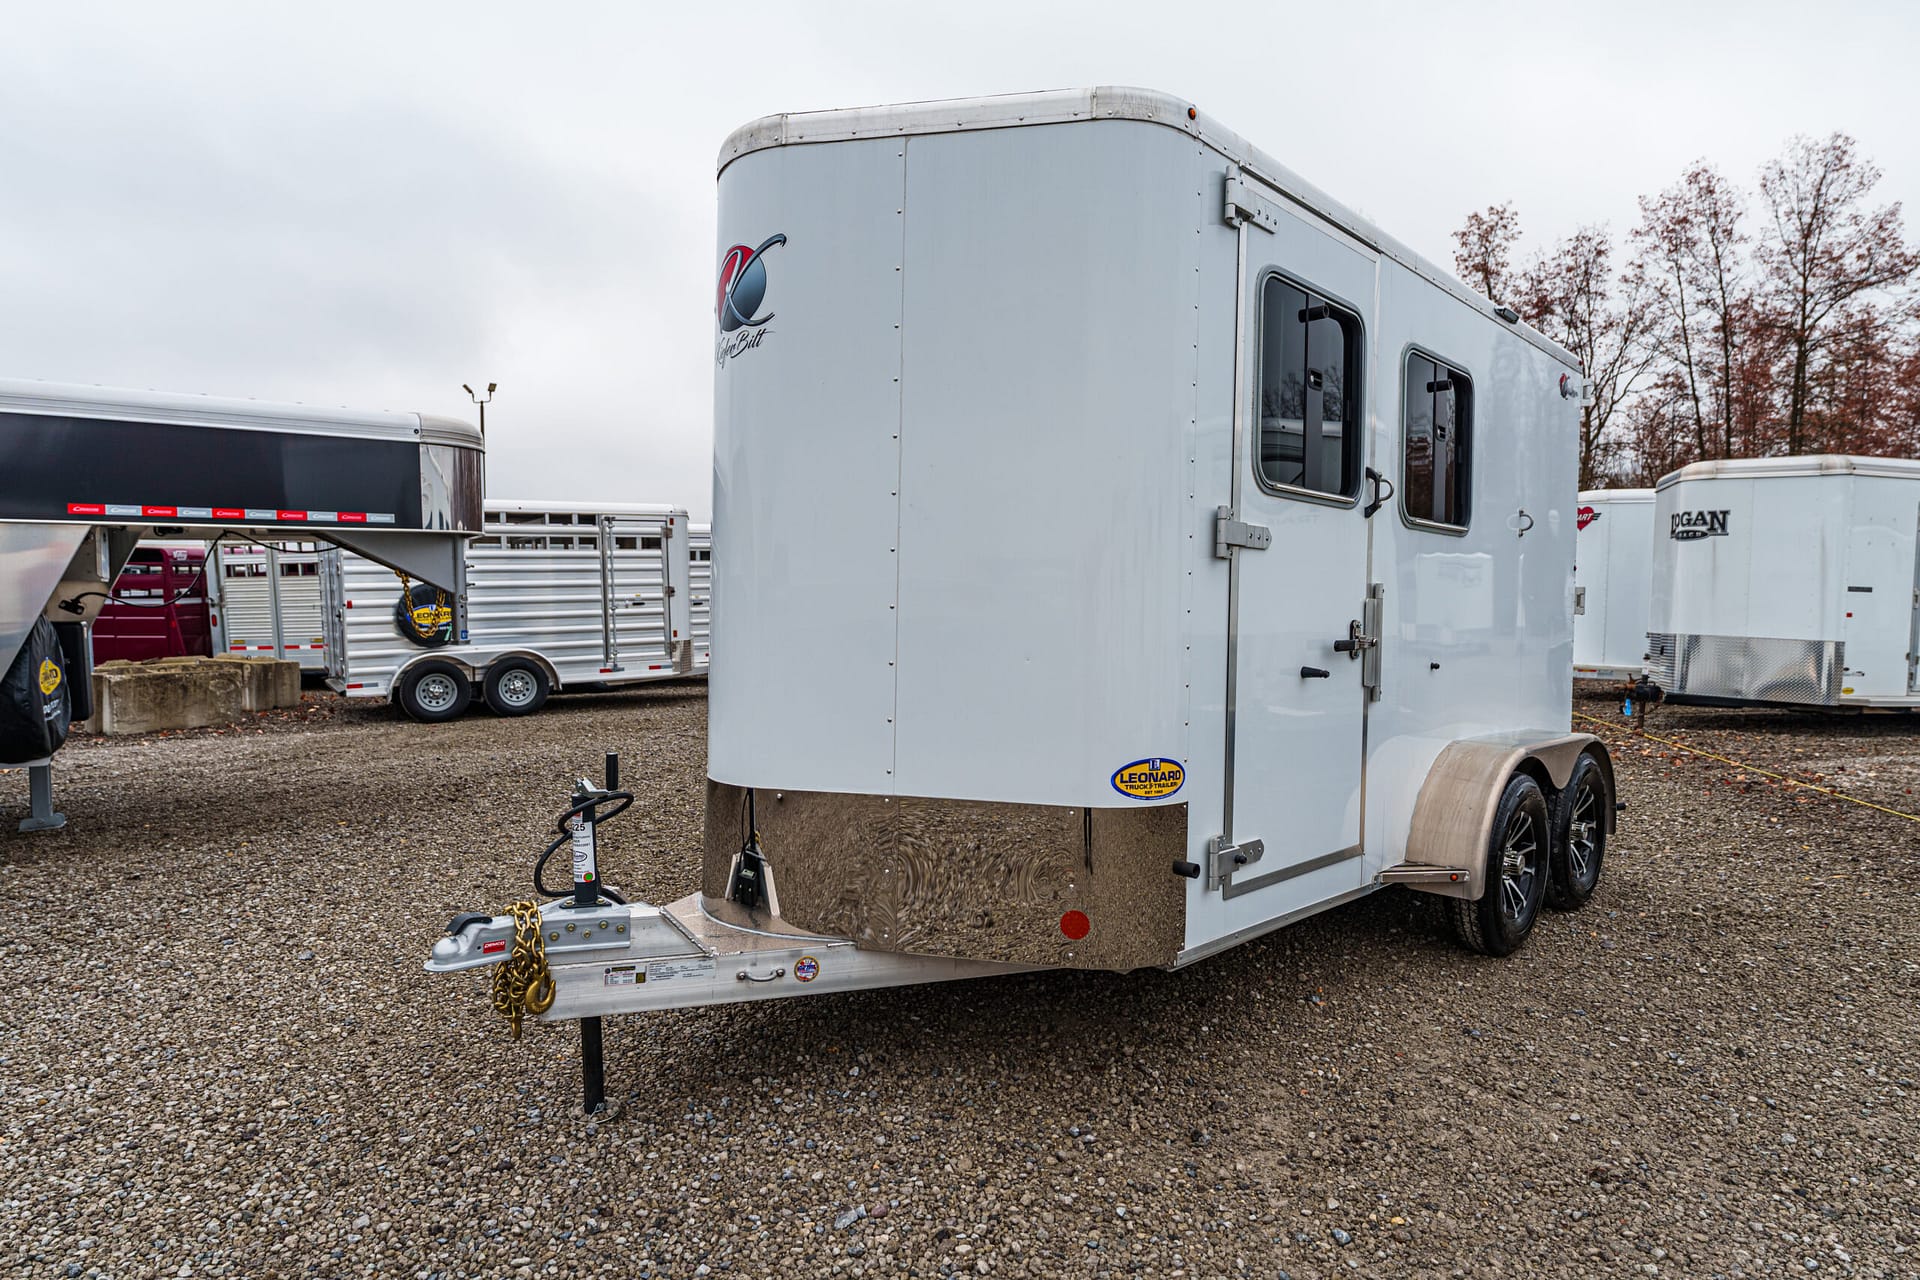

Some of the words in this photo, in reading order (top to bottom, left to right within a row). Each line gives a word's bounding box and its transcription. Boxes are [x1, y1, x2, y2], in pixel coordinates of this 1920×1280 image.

[1577, 513, 1593, 521] ART
[1671, 510, 1731, 536] LOGAN
[1119, 770, 1181, 784] LEONARD
